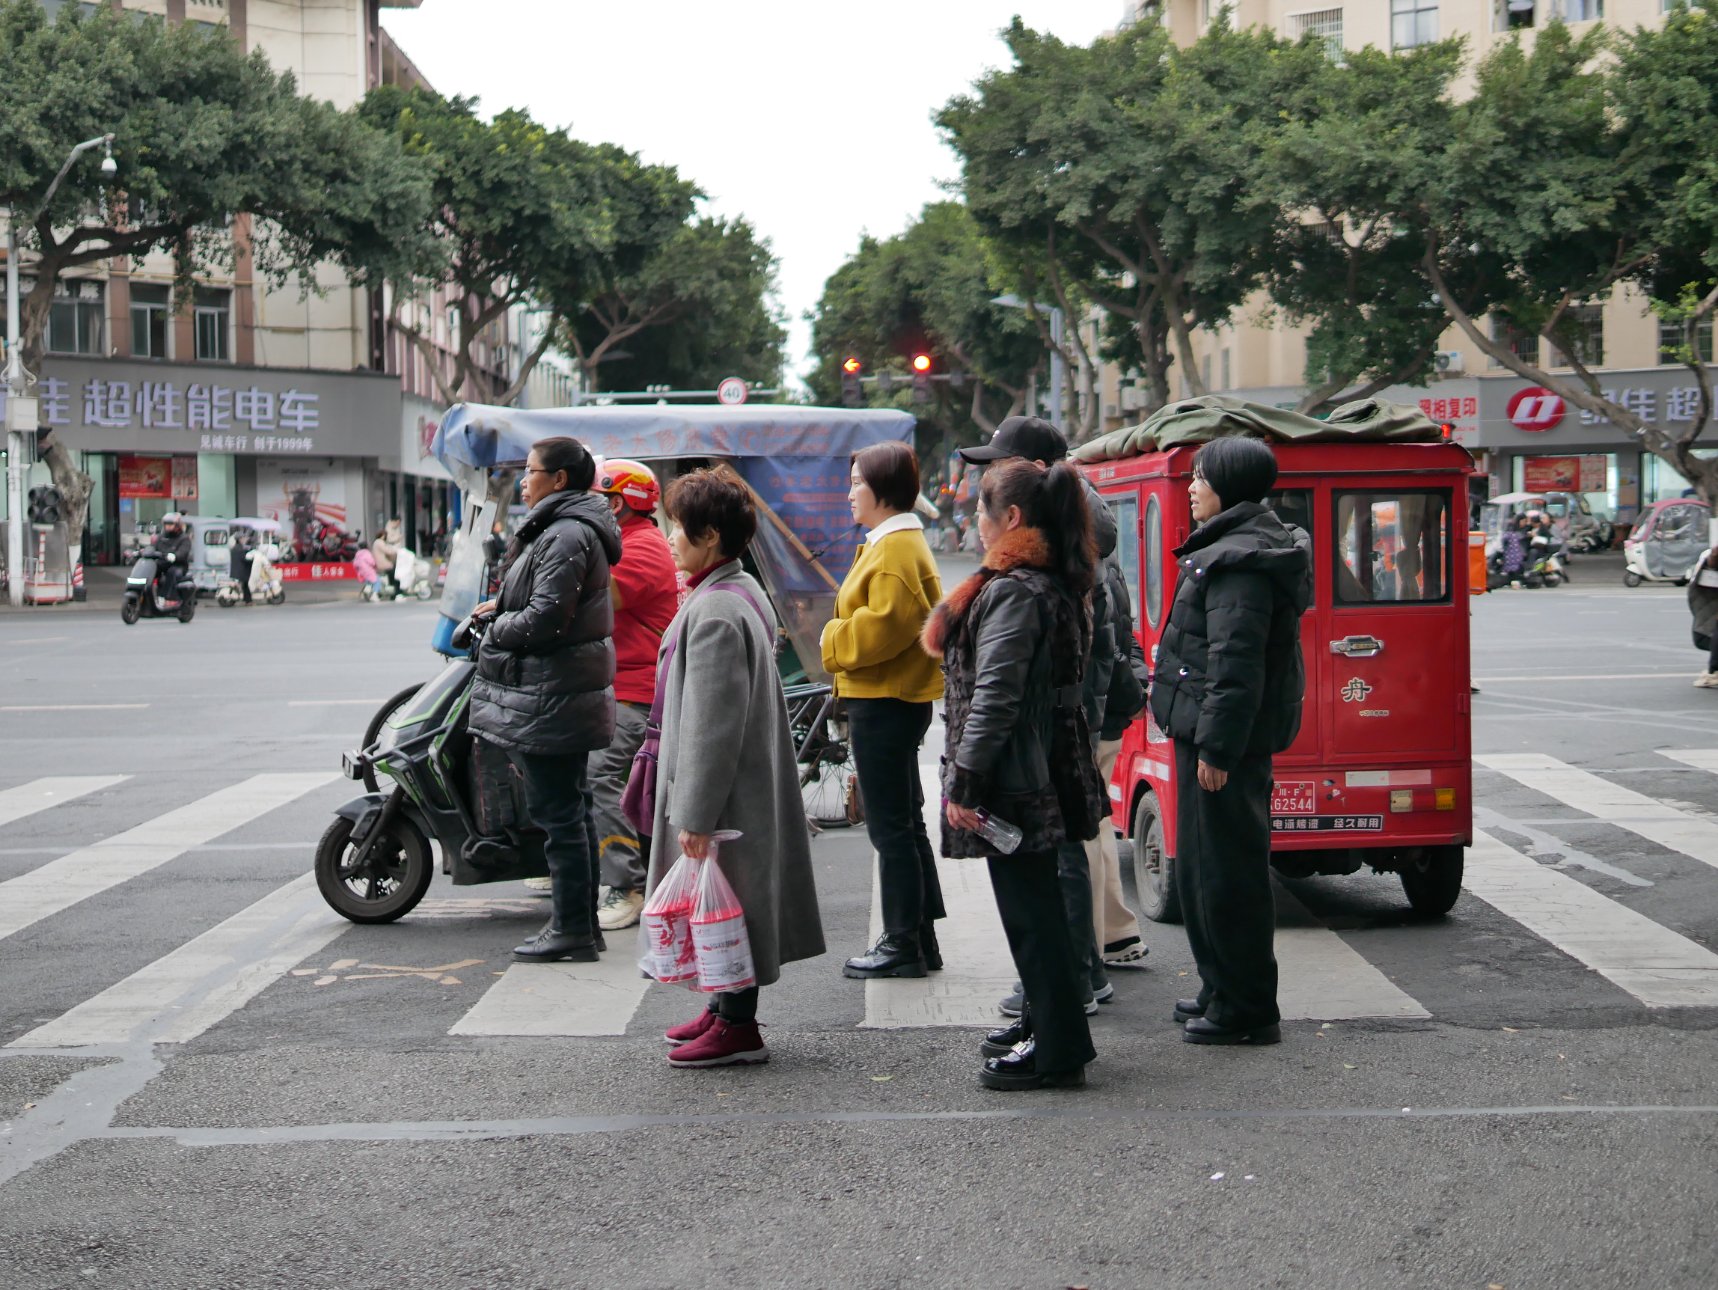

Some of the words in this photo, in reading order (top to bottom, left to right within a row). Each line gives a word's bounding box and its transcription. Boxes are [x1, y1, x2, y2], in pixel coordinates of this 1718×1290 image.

[723, 386, 740, 399] 40
[0, 376, 319, 432] 佳超性能电车
[1333, 818, 1379, 828] 经久耐用
